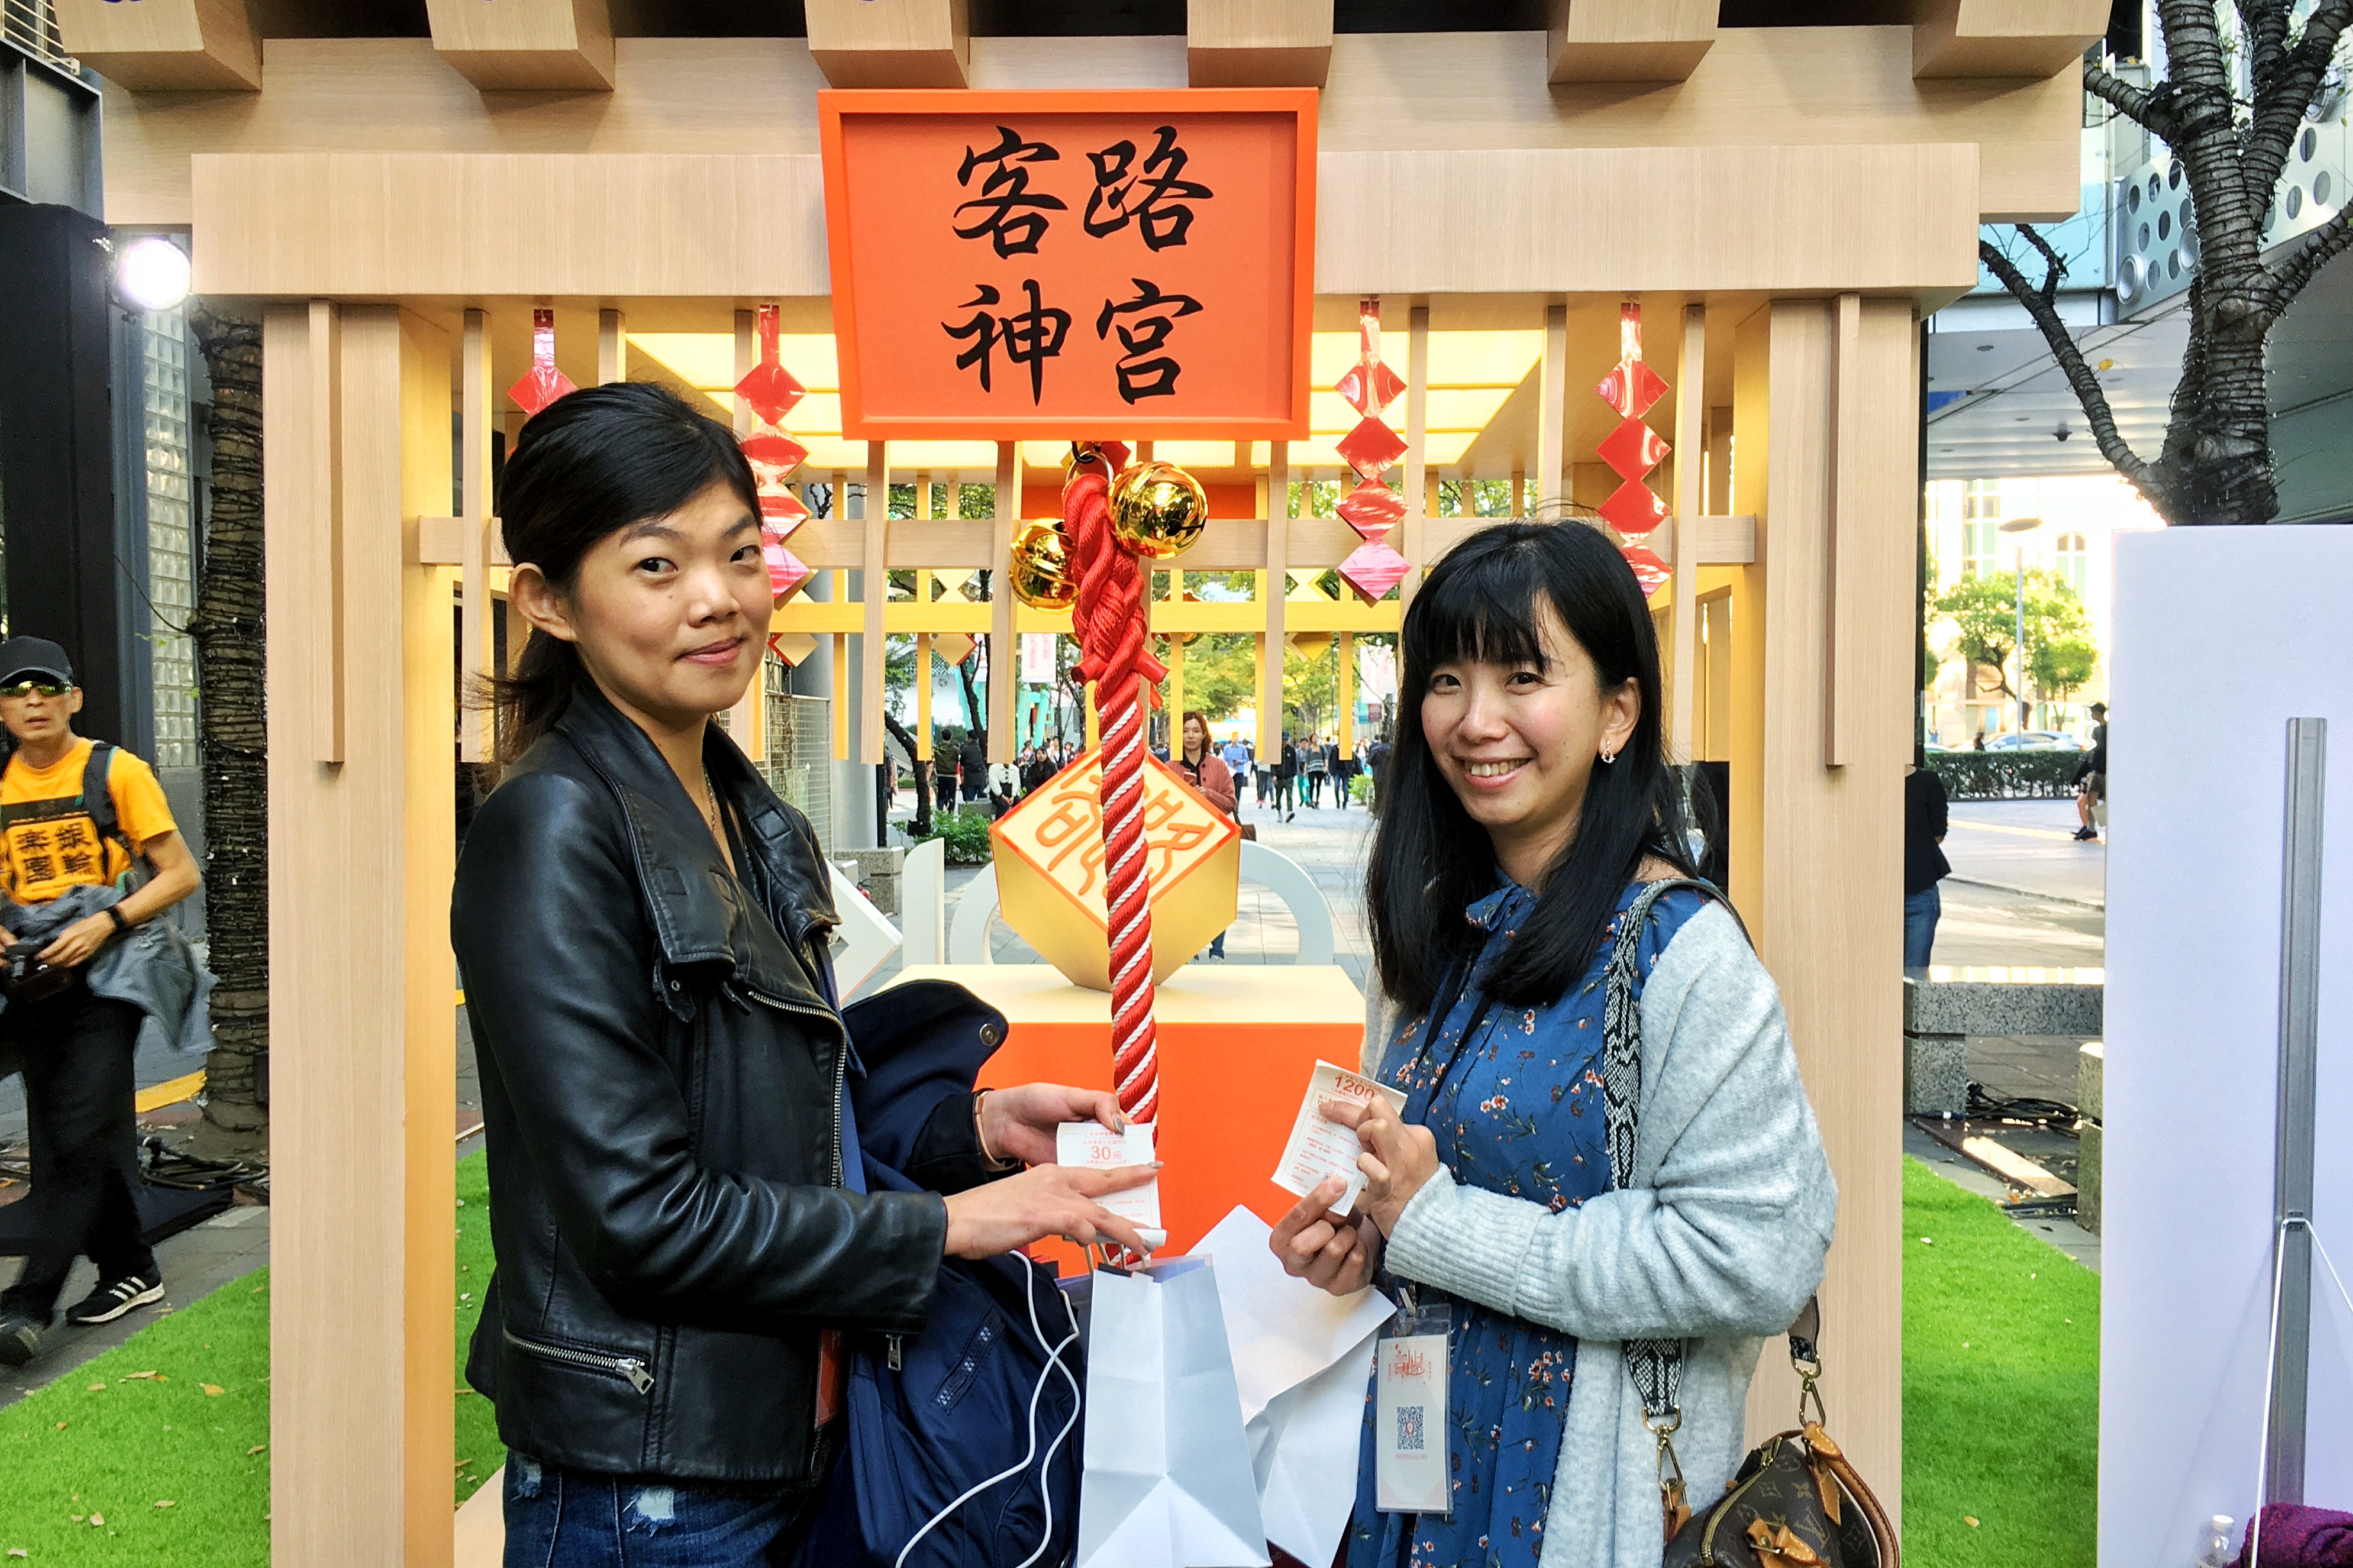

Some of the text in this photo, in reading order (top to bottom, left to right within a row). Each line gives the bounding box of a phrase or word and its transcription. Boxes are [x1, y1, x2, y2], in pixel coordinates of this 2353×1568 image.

[951, 124, 1214, 260] 客路
[940, 277, 1203, 407] 神宮
[1335, 1075, 1375, 1101] 1200
[1090, 1145, 1122, 1160] 30元
